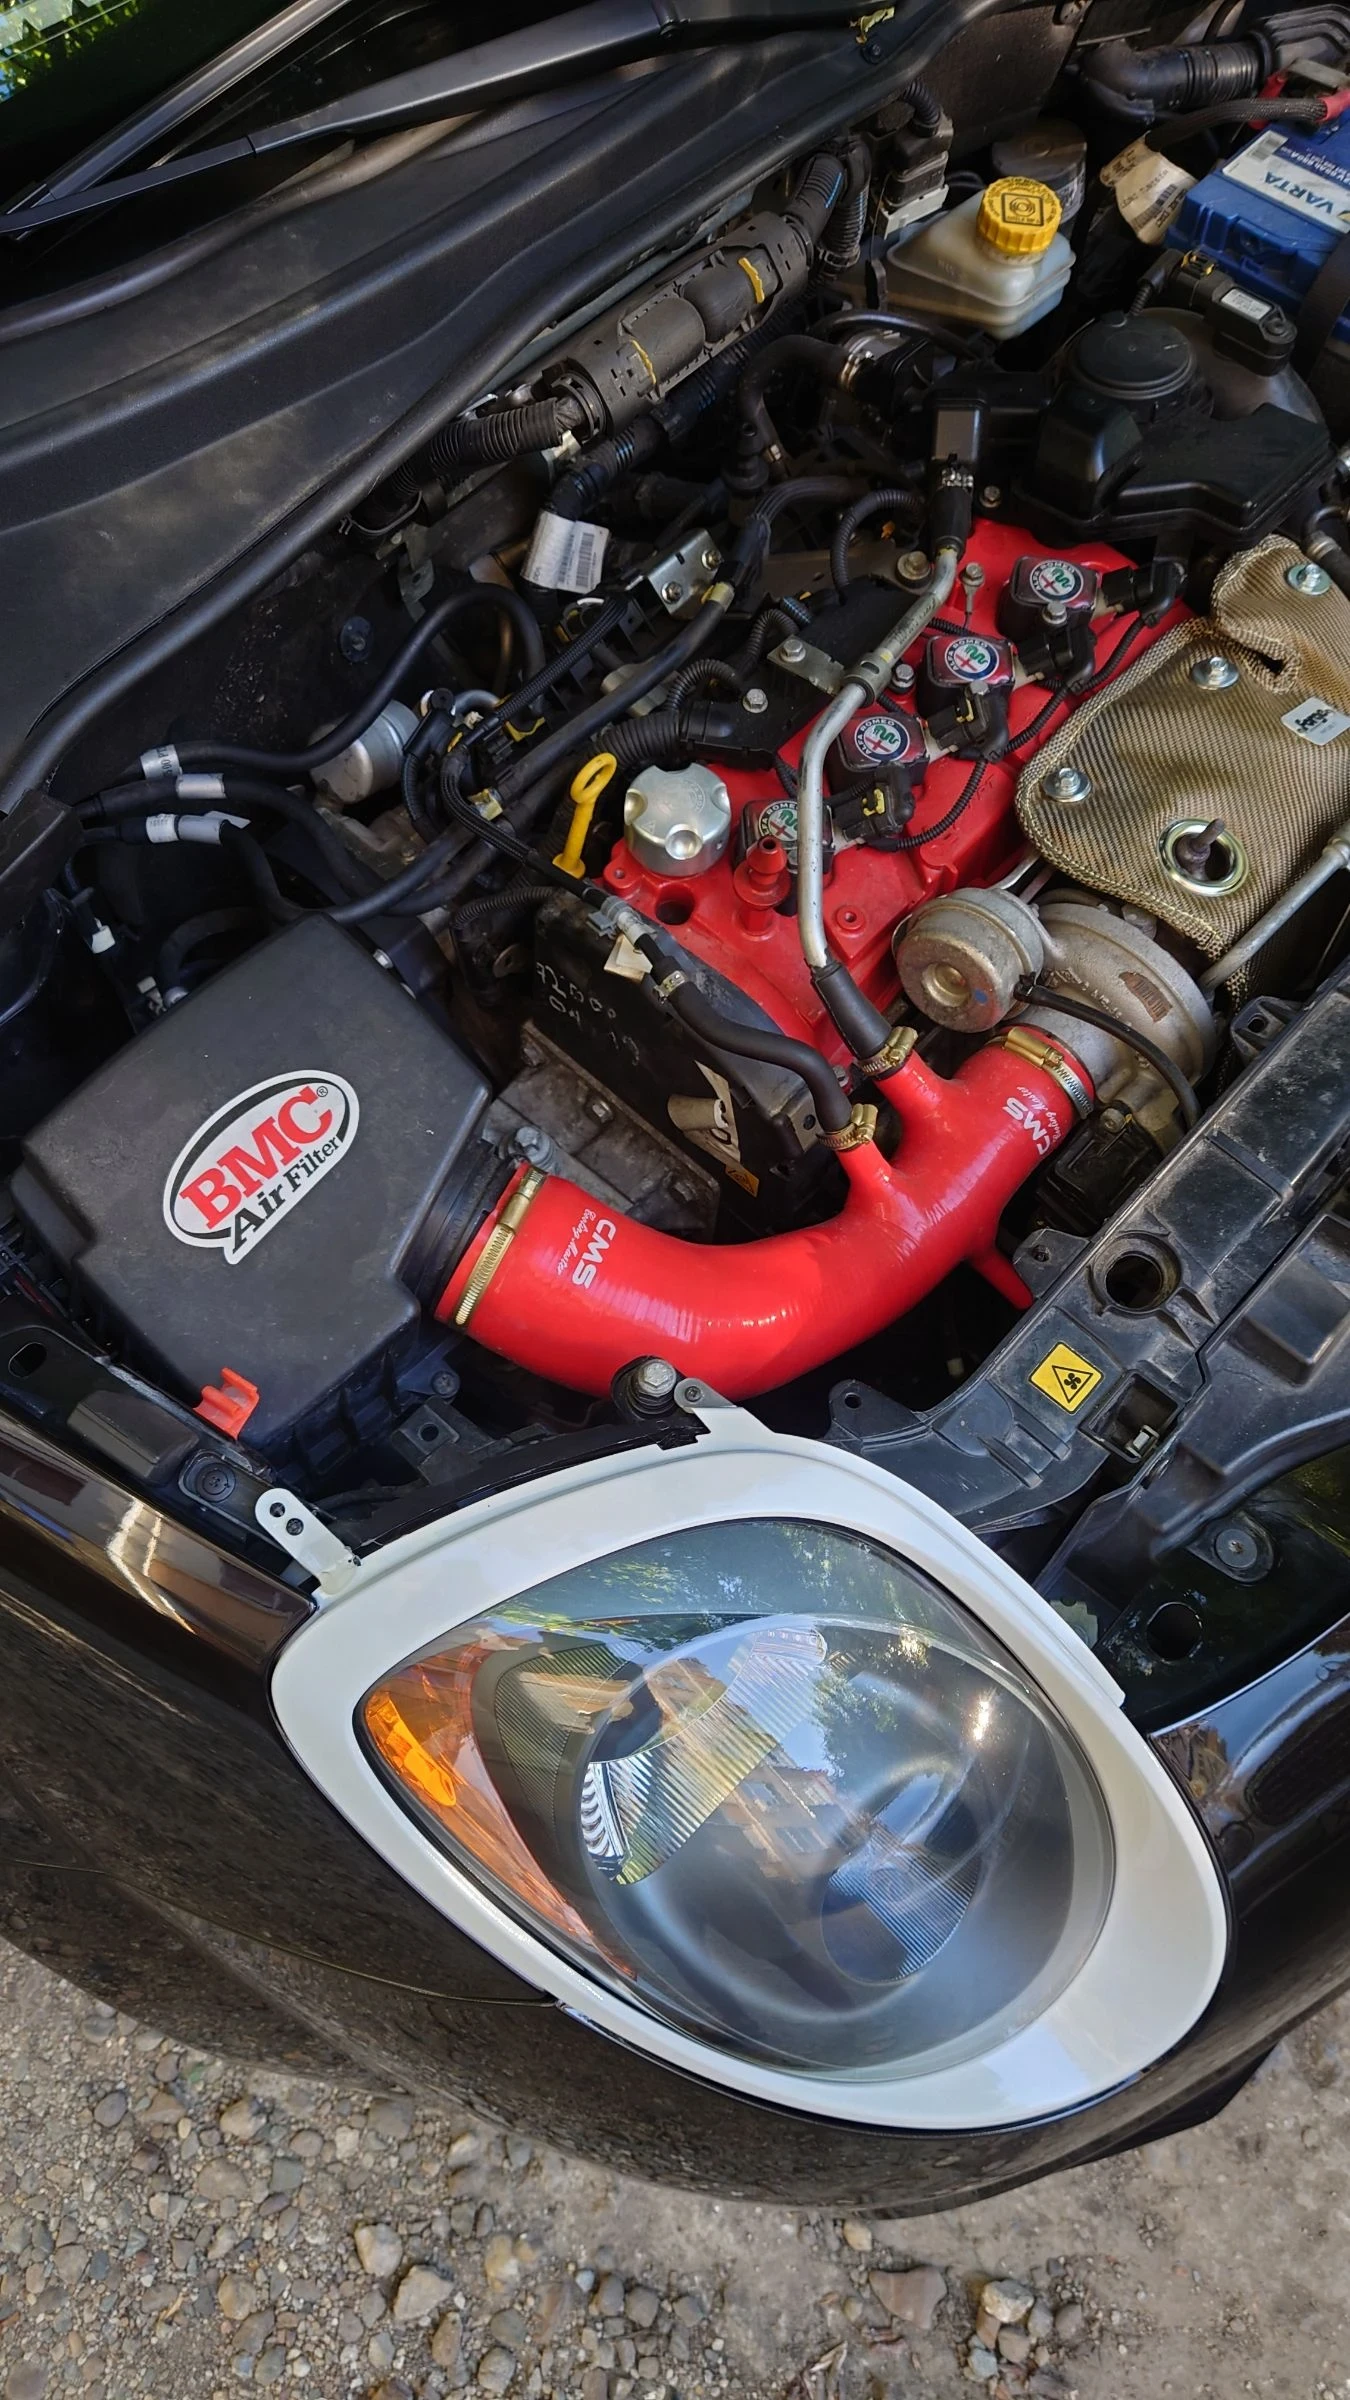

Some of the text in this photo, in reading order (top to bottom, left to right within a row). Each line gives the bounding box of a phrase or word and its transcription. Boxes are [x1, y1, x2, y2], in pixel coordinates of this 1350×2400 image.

[1264, 172, 1335, 214] VARTA
[1040, 561, 1076, 574] ROMEO
[947, 639, 988, 671] ALFA ROMEO
[857, 719, 896, 755] ALFA ROMEO
[766, 803, 799, 815] ROME
[1016, 1086, 1049, 1111] Master
[1002, 1097, 1051, 1155] CMS
[179, 1085, 333, 1230] BMC
[232, 1136, 340, 1255] Air Filter
[556, 1208, 597, 1276] Cooling Master
[572, 1219, 617, 1289] CMS
